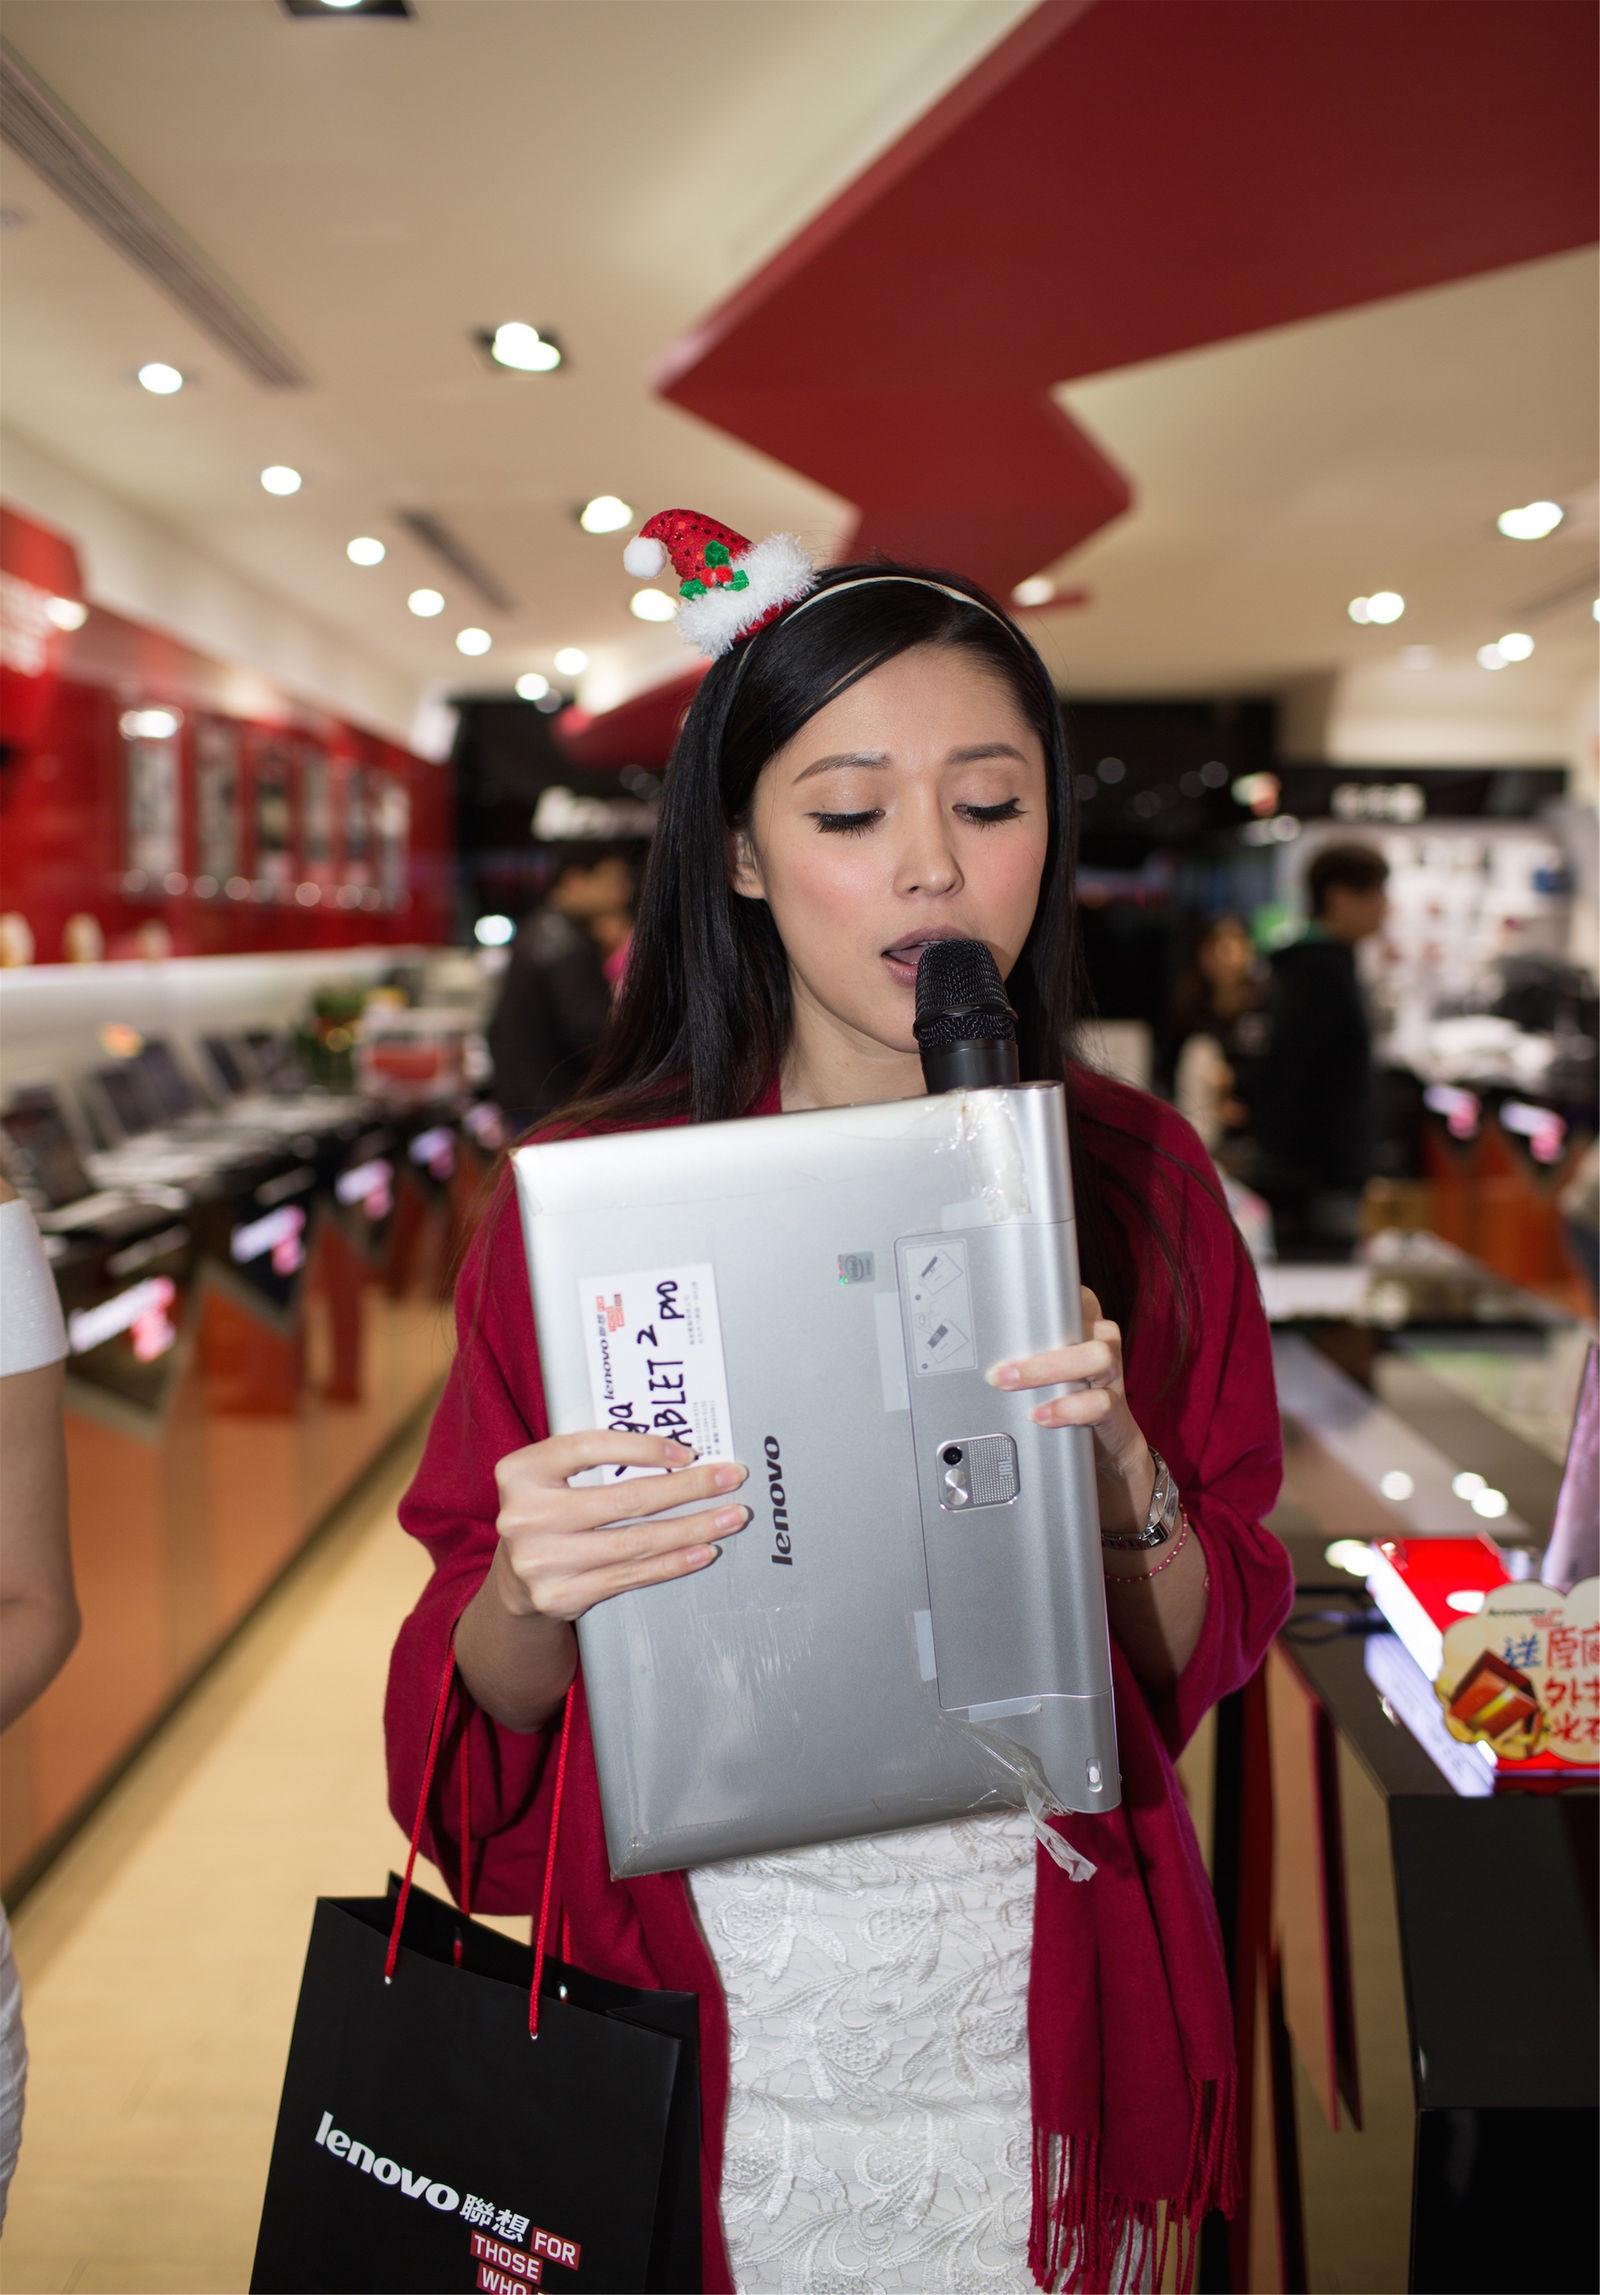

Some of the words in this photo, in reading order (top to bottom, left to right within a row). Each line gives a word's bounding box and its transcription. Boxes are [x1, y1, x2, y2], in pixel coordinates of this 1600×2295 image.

[636, 1324, 659, 1347] 2
[600, 1338, 615, 1400] lenovo
[646, 1359, 699, 1473] ABLET
[997, 1456, 1014, 1480] JBL
[764, 1435, 793, 1566] lenovo
[315, 2110, 460, 2212] lenovo
[459, 2194, 531, 2243] 聯想
[533, 2231, 577, 2265] FOR
[474, 2234, 541, 2281] THOSE
